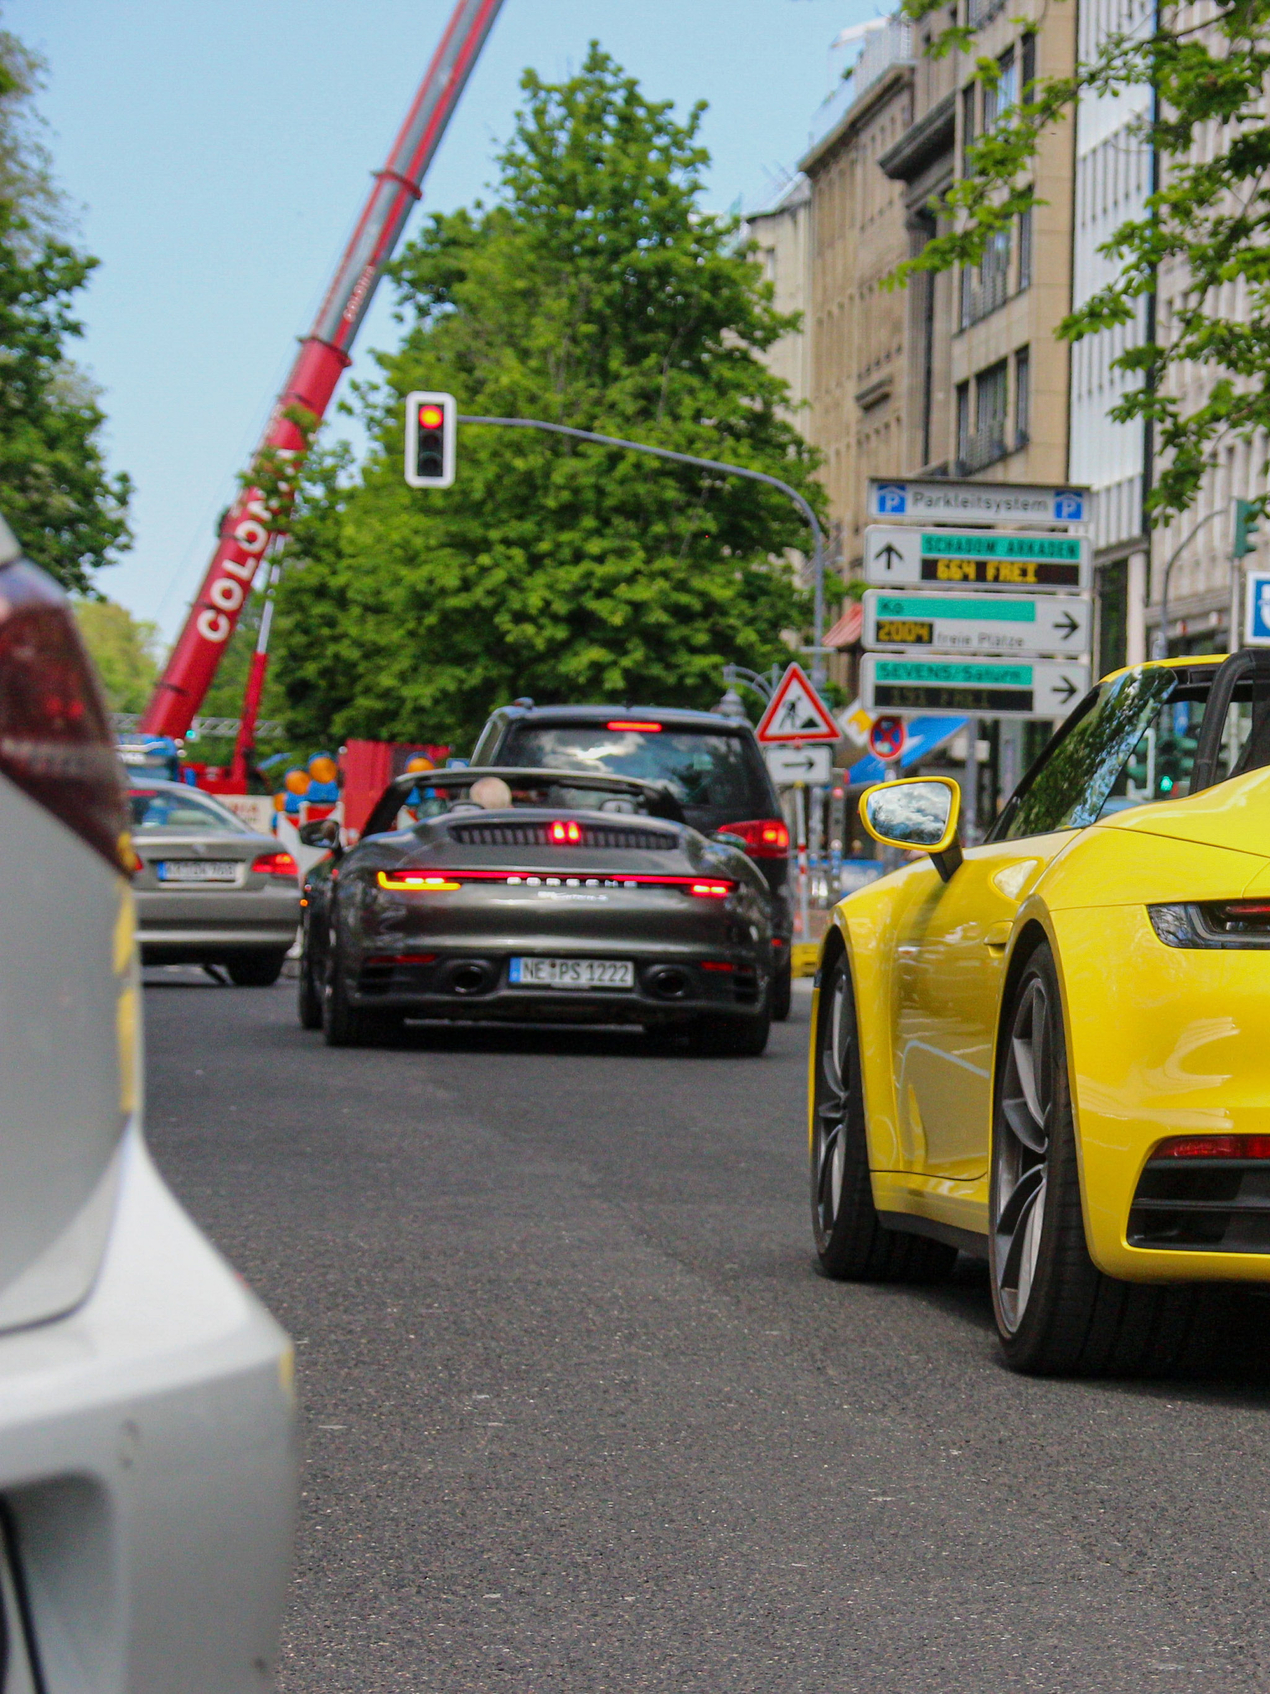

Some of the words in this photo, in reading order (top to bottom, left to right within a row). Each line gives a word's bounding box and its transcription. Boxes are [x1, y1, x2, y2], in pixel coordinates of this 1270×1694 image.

[911, 491, 1048, 513] Parkleitsystem
[936, 559, 976, 582] 664
[985, 561, 1039, 584] FREI
[877, 620, 931, 643] 2004
[522, 961, 545, 981] NE
[559, 962, 581, 981] PS
[585, 963, 629, 984] 1222
